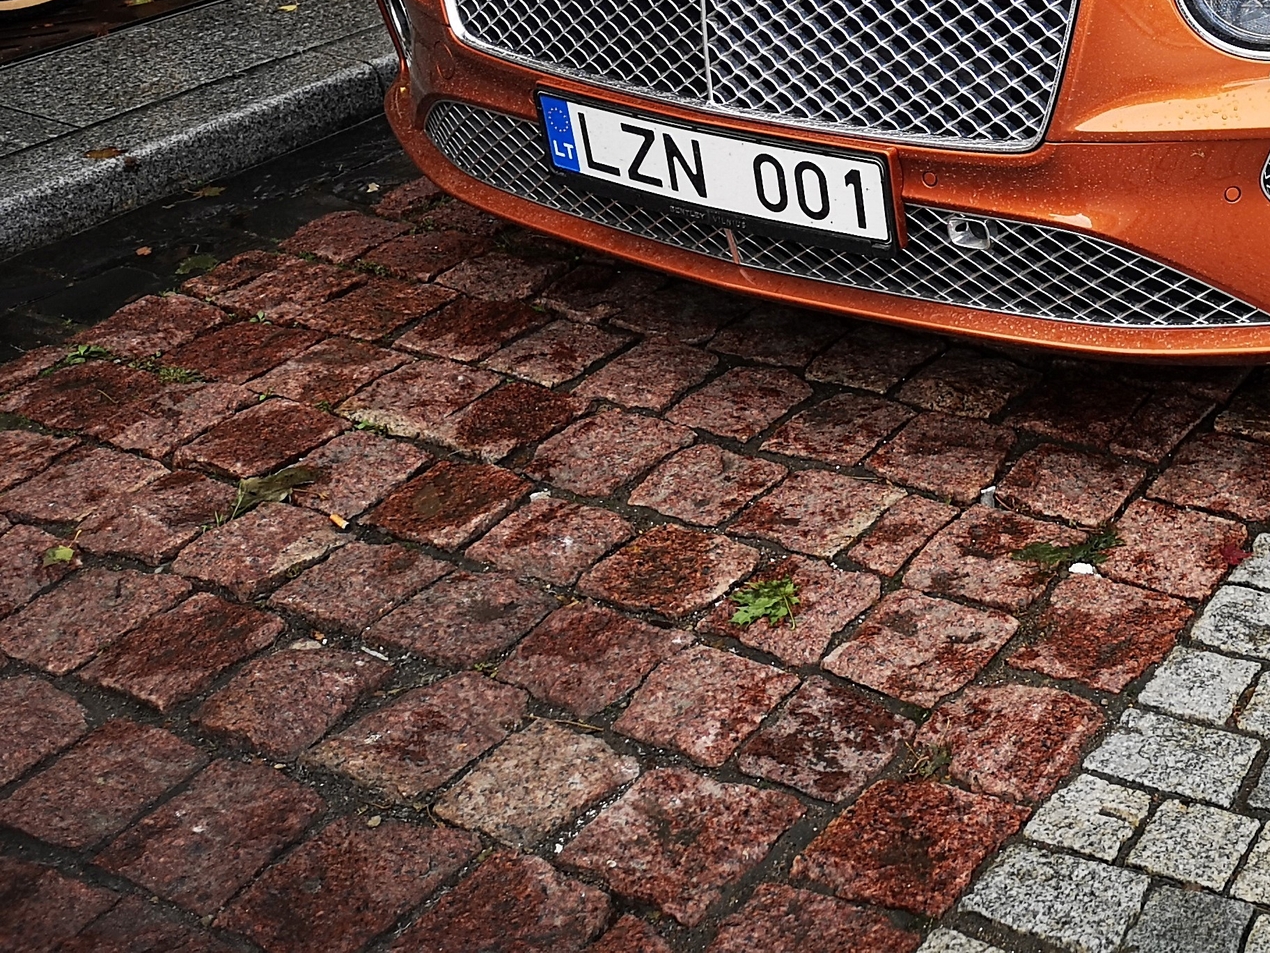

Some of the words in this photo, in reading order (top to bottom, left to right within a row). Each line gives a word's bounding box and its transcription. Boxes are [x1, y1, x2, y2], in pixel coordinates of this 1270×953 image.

[553, 138, 575, 161] LT
[577, 111, 708, 199] LZN
[752, 153, 867, 230] 001
[669, 205, 706, 220] BENTLEY
